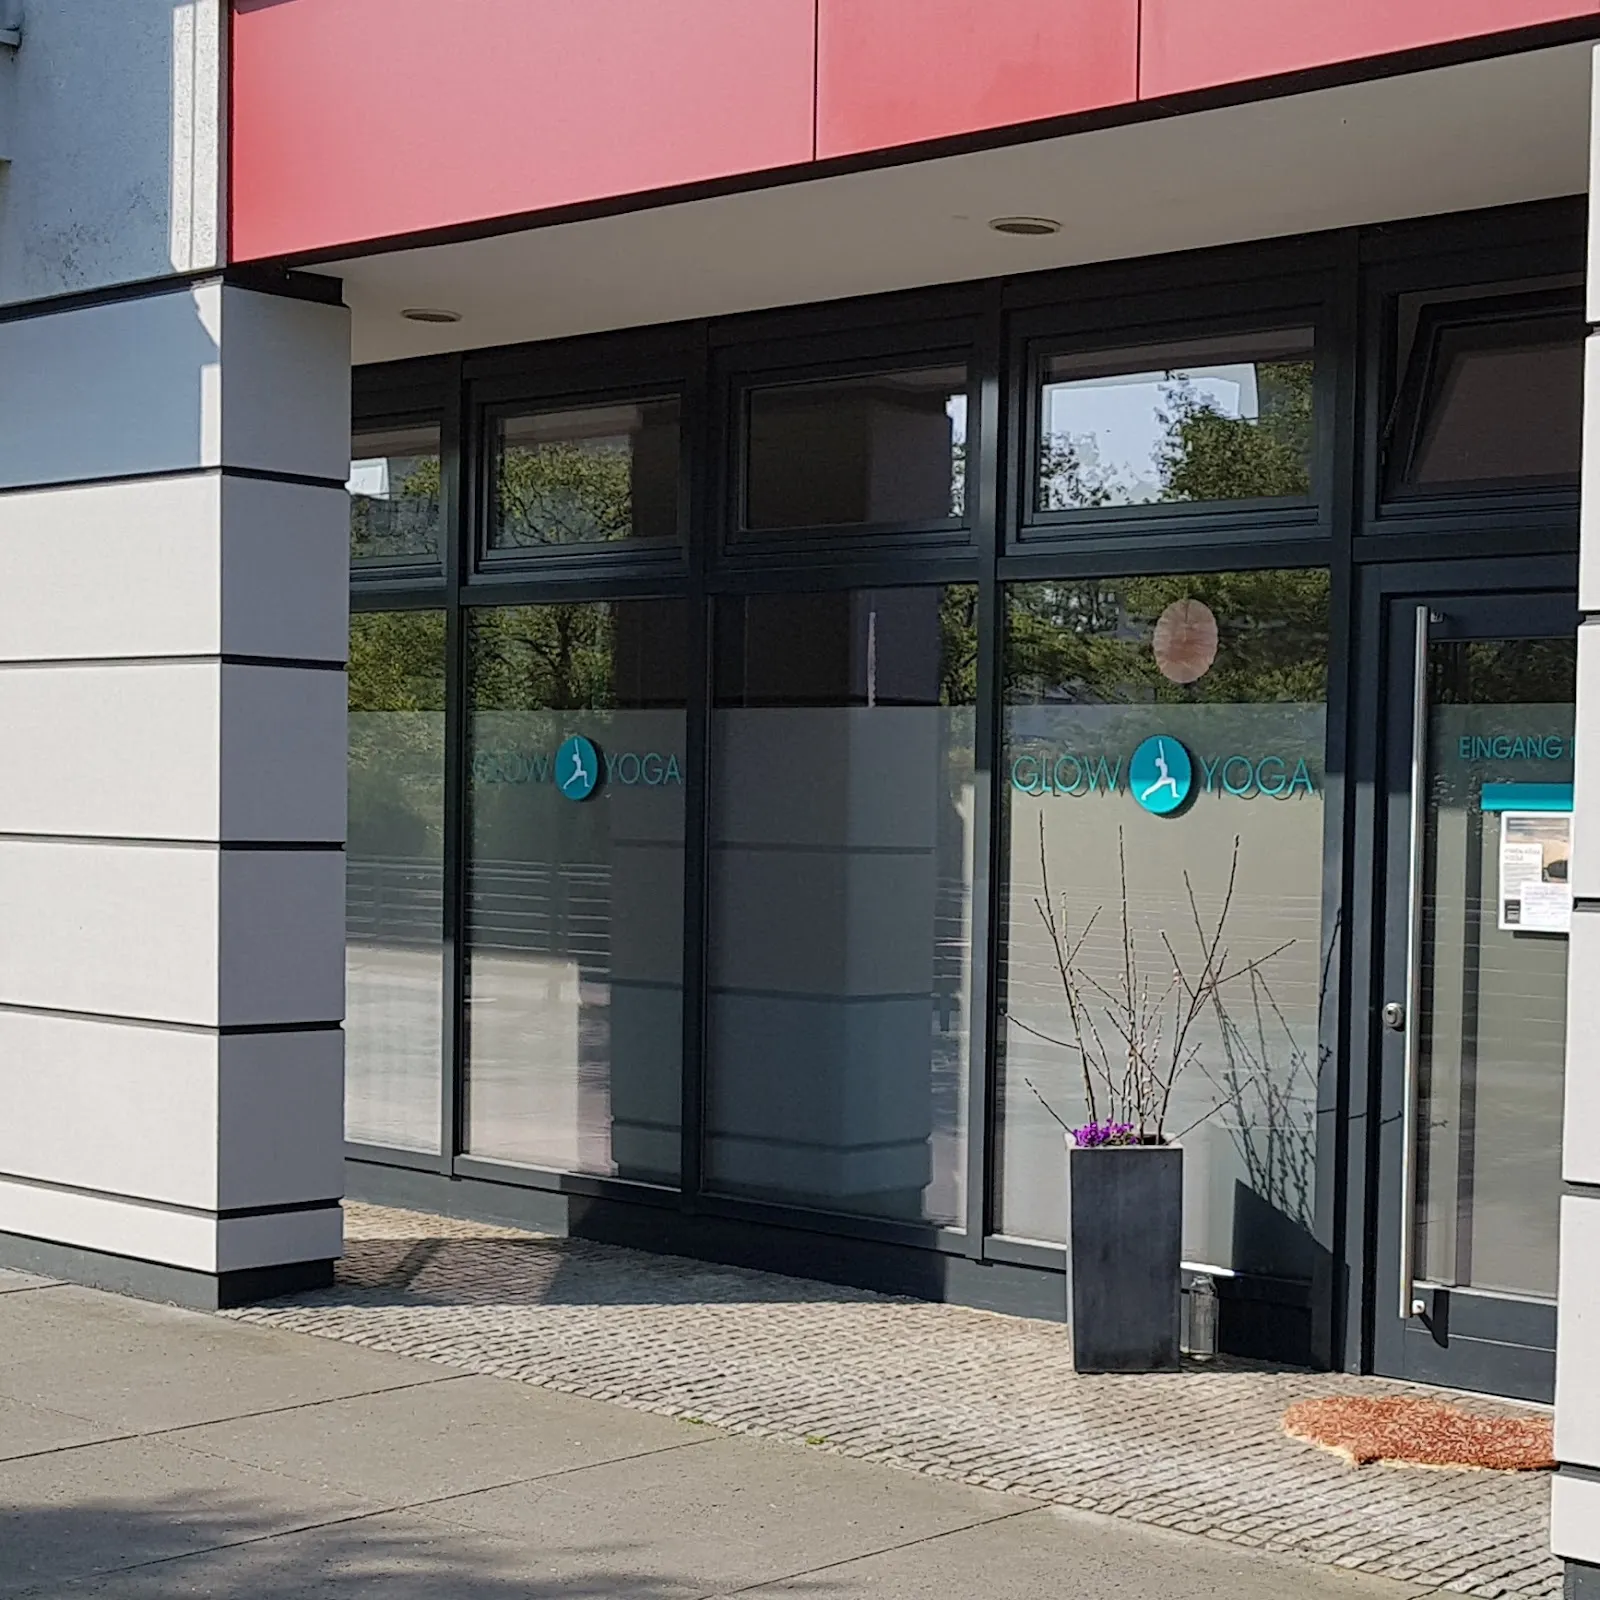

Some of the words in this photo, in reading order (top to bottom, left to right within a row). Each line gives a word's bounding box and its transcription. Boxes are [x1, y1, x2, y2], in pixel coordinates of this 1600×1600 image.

[1459, 736, 1564, 760] EINGANG
[604, 753, 683, 784] YOGA
[1012, 756, 1122, 793] GLOW
[1200, 756, 1314, 795] YOGA
